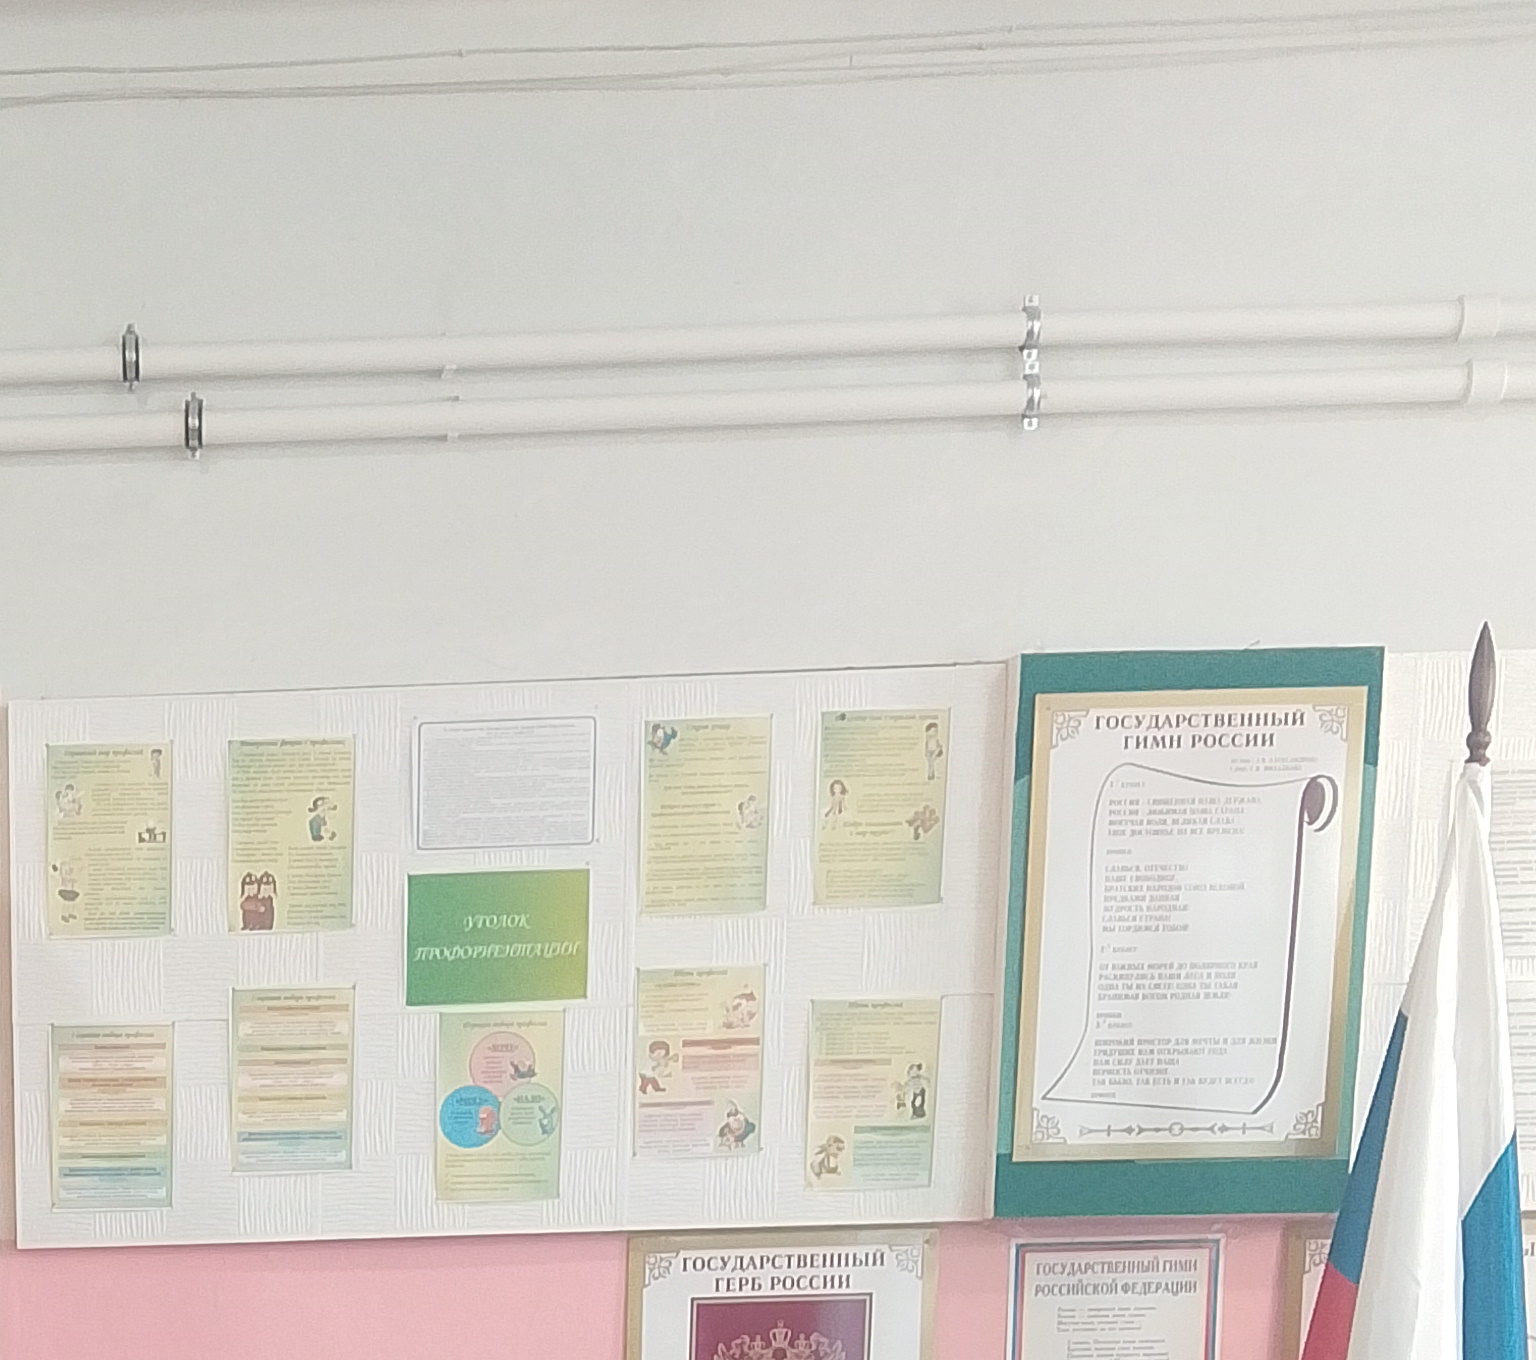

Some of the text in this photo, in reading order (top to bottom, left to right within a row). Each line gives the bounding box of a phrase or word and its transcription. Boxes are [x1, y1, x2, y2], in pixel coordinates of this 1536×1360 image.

[1095, 709, 1306, 731] ГОСУДАРСТВЕННЫЙ
[1123, 733, 1275, 750] ГИМН РОССИИ
[464, 914, 530, 931] УГОЛОК
[681, 1250, 885, 1272] ГОСУДАРСТВЕННЫЙ
[1036, 1256, 1198, 1276] ГОСУДАРСТВЕННЫЙ ГИМН
[714, 1274, 851, 1292] ГЕРБ РОССИИ
[1034, 1279, 1197, 1297] РОССИЙСКОЙ ФЕДЕРАЦИИ
